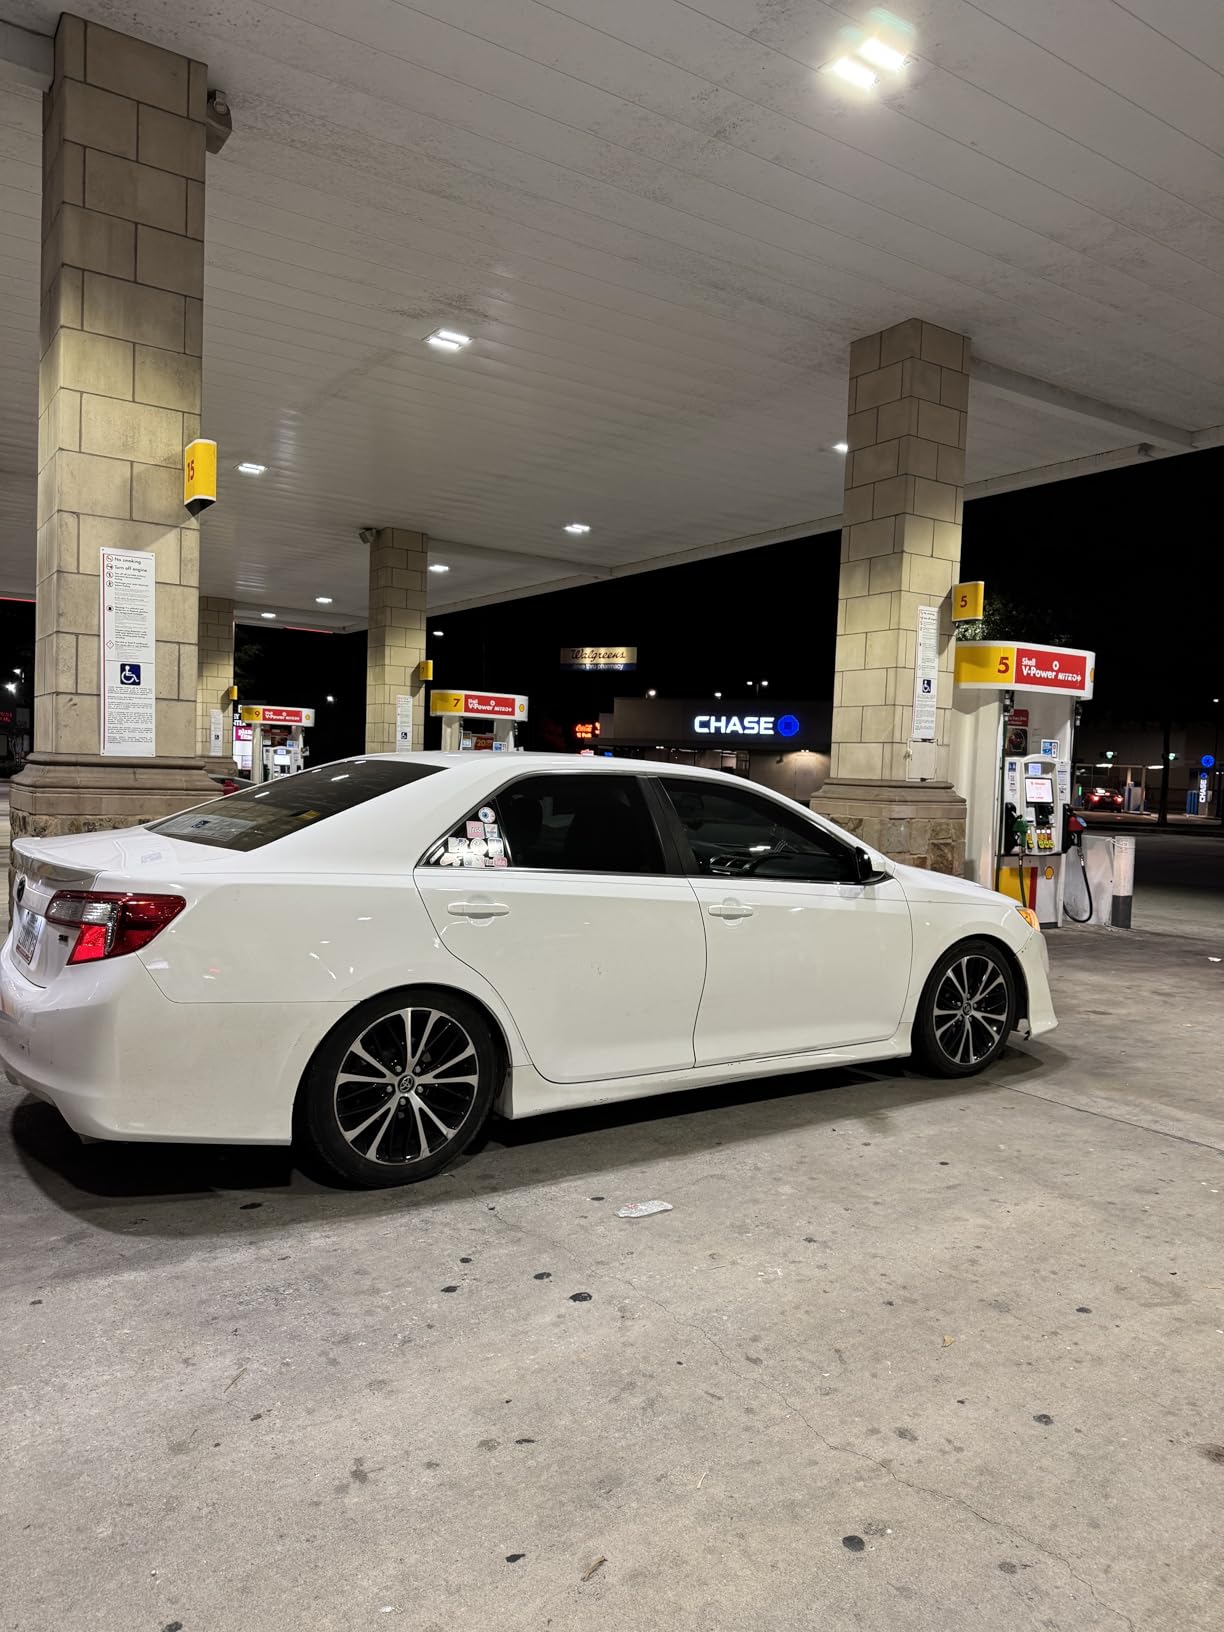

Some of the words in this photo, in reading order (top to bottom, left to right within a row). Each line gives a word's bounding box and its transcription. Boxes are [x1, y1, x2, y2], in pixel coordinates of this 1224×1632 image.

[187, 459, 195, 482] 15
[960, 595, 968, 608] 5
[570, 648, 626, 662] Walgreens
[997, 656, 1010, 674] 5
[1022, 658, 1036, 666] Shell
[1022, 666, 1056, 679] V-Power
[453, 699, 460, 708] 7
[694, 716, 775, 734] CHASE
